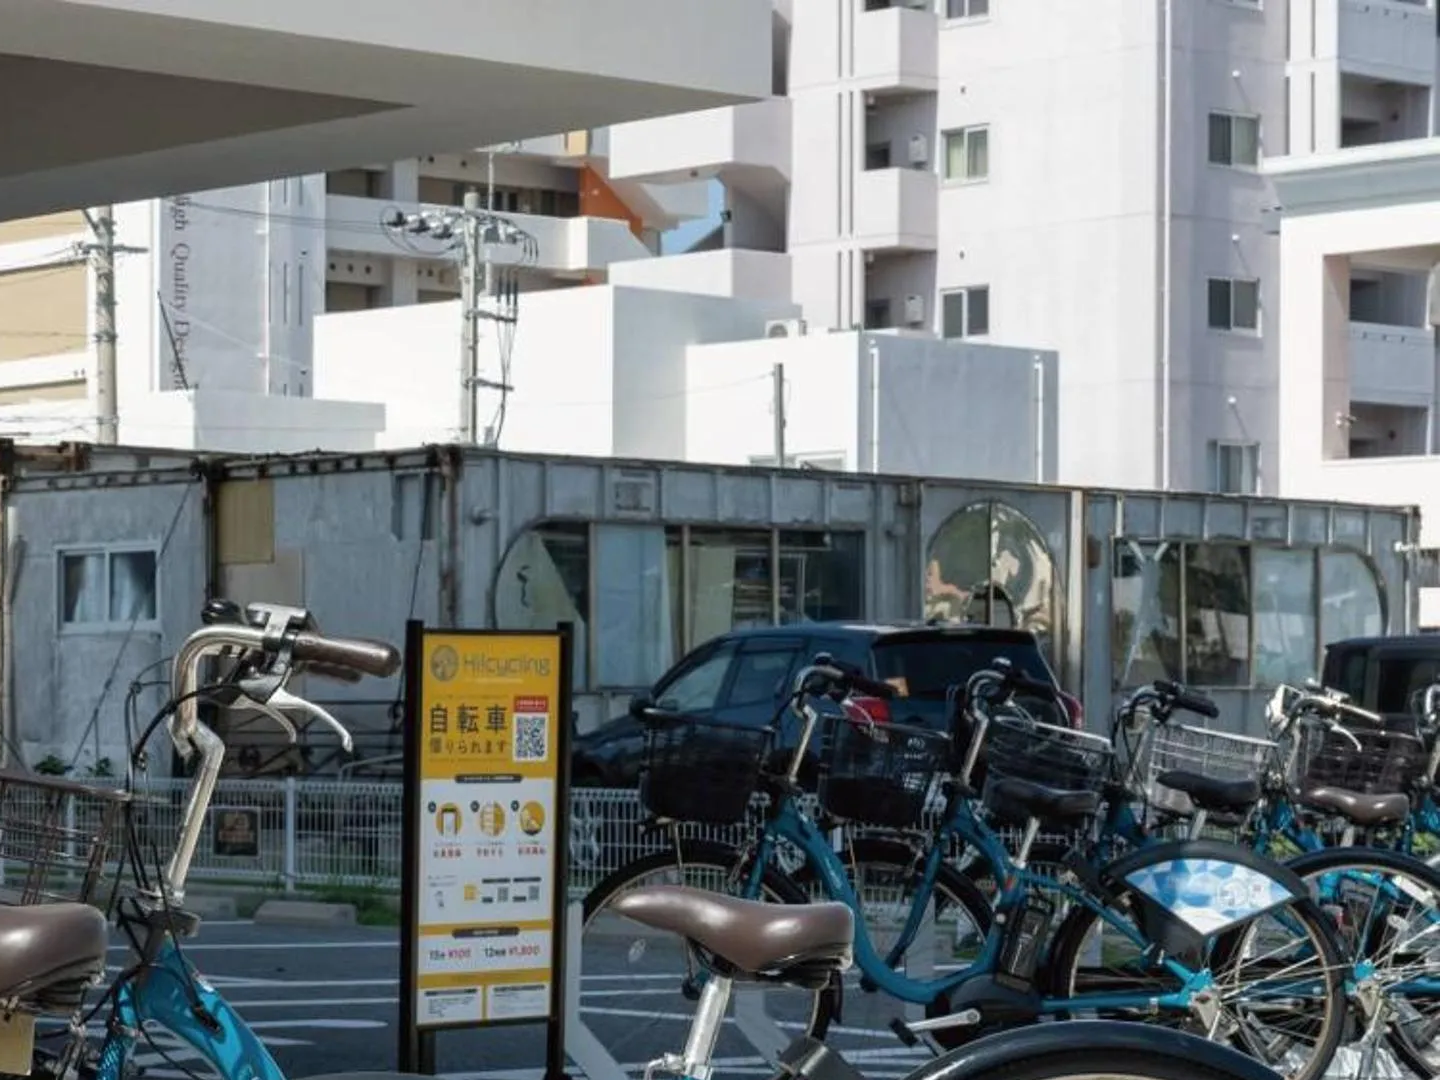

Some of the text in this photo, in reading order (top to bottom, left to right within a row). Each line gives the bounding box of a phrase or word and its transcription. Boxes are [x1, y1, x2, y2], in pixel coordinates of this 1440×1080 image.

[171, 194, 191, 231] igh
[169, 243, 190, 312] Quality
[429, 702, 508, 735] 自転車
